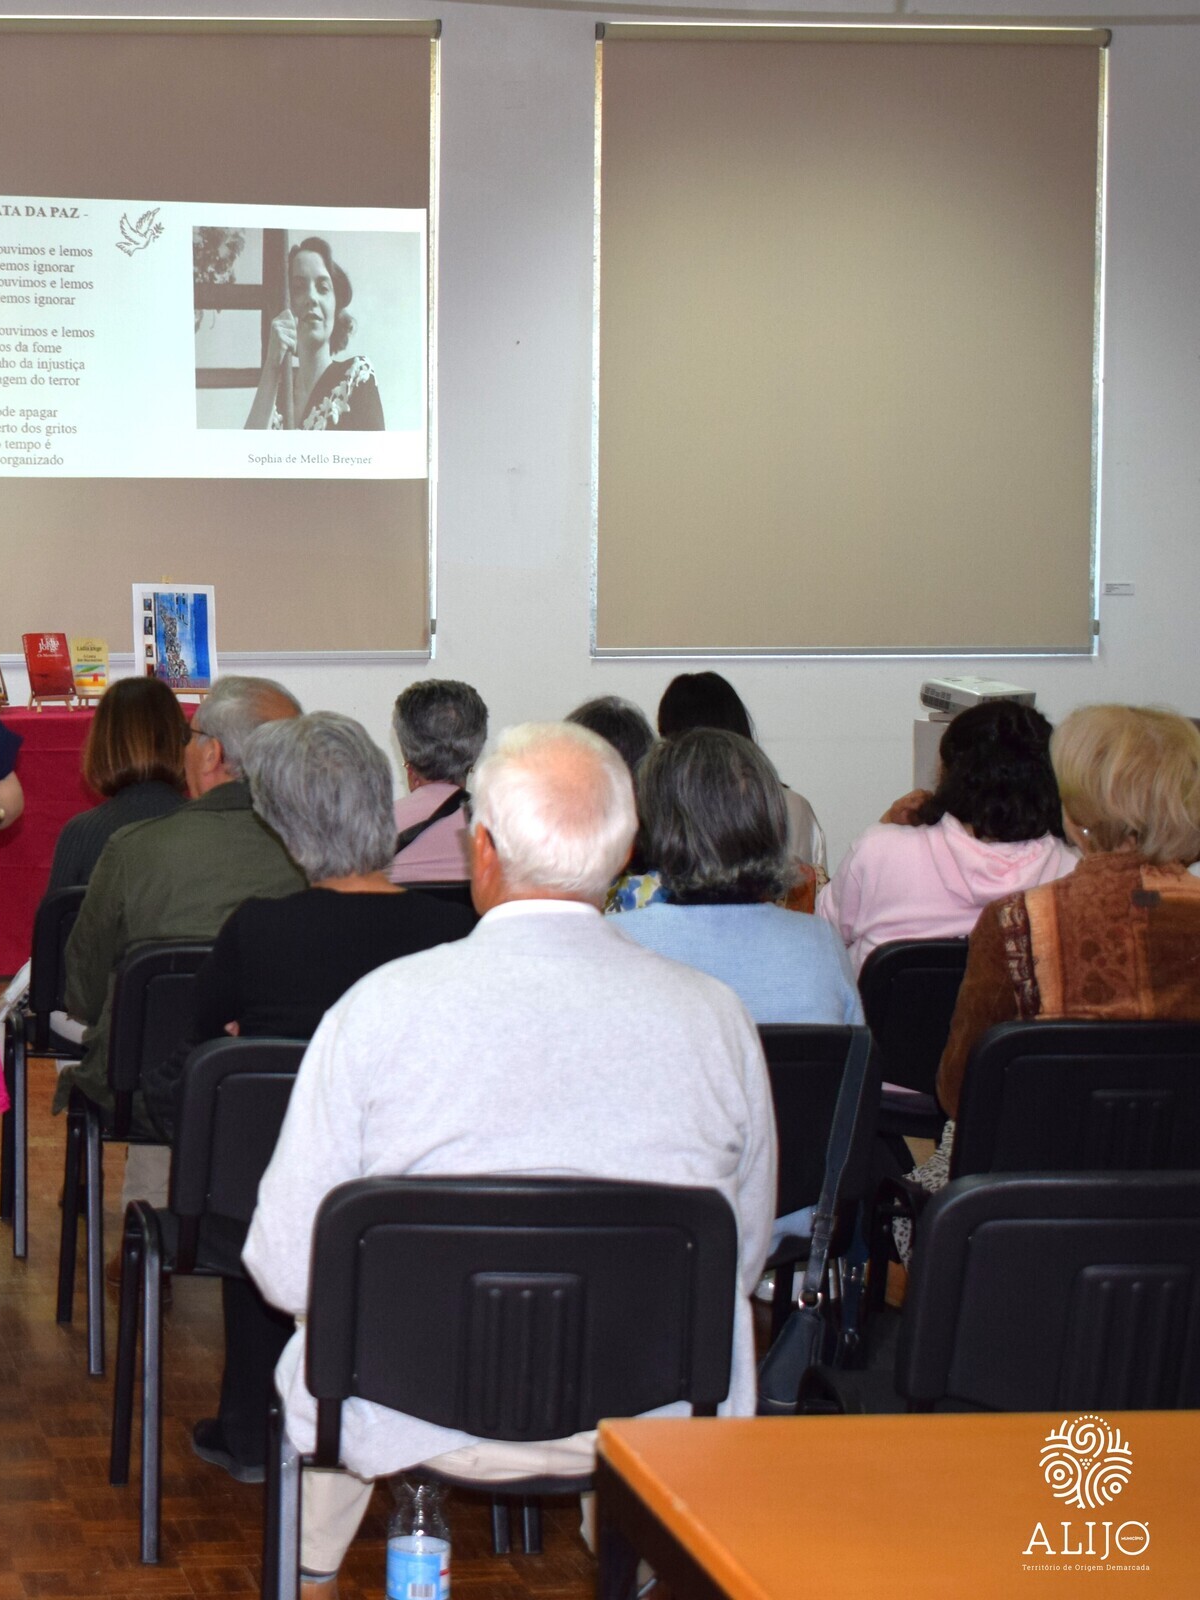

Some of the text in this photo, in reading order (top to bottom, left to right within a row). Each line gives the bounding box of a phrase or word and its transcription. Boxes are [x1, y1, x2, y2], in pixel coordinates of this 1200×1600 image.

[25, 206, 46, 217] DA
[50, 207, 79, 219] PAZ
[49, 247, 55, 256] e
[59, 245, 93, 257] lemos
[33, 261, 74, 275] ignorar
[50, 280, 56, 288] e
[60, 278, 94, 289] lemos
[34, 293, 75, 307] ignorar
[0, 326, 48, 337] ouvimos
[51, 329, 57, 337] e
[62, 326, 94, 338] lemos
[15, 341, 28, 352] da
[33, 341, 62, 353] fome
[20, 358, 33, 369] da
[37, 358, 85, 372] injustiça
[31, 374, 45, 385] do
[49, 376, 80, 386] terror
[19, 409, 57, 420] apagar
[21, 423, 41, 433] dos
[45, 423, 77, 436] gritos
[5, 440, 41, 452] tempo
[45, 440, 51, 450] é
[0, 454, 63, 467] organizado
[248, 454, 372, 466] Sophia de Mello Breyner
